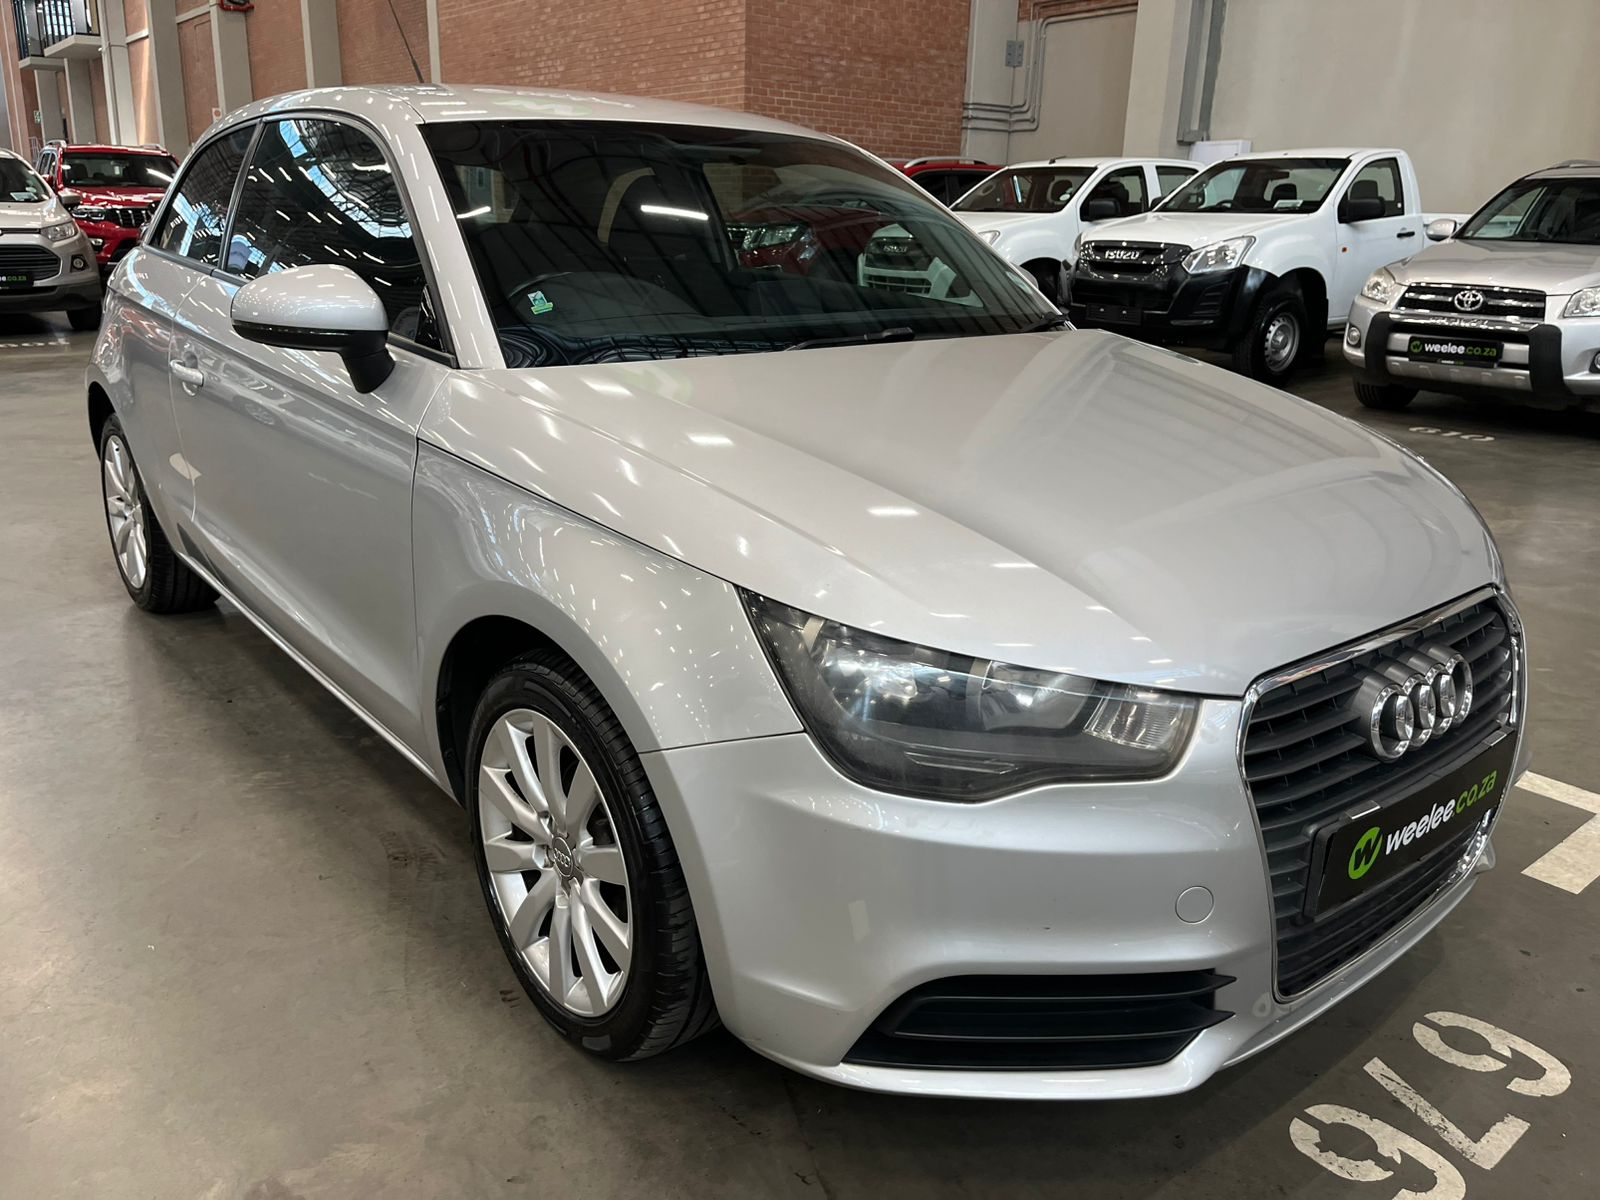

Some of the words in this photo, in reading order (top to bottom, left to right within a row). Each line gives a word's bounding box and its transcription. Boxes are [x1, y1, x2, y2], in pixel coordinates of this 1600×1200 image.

[1105, 250, 1140, 260] ISUZU
[1424, 342, 1497, 357] weelee.co.za
[1385, 769, 1498, 856] weelee.co.za
